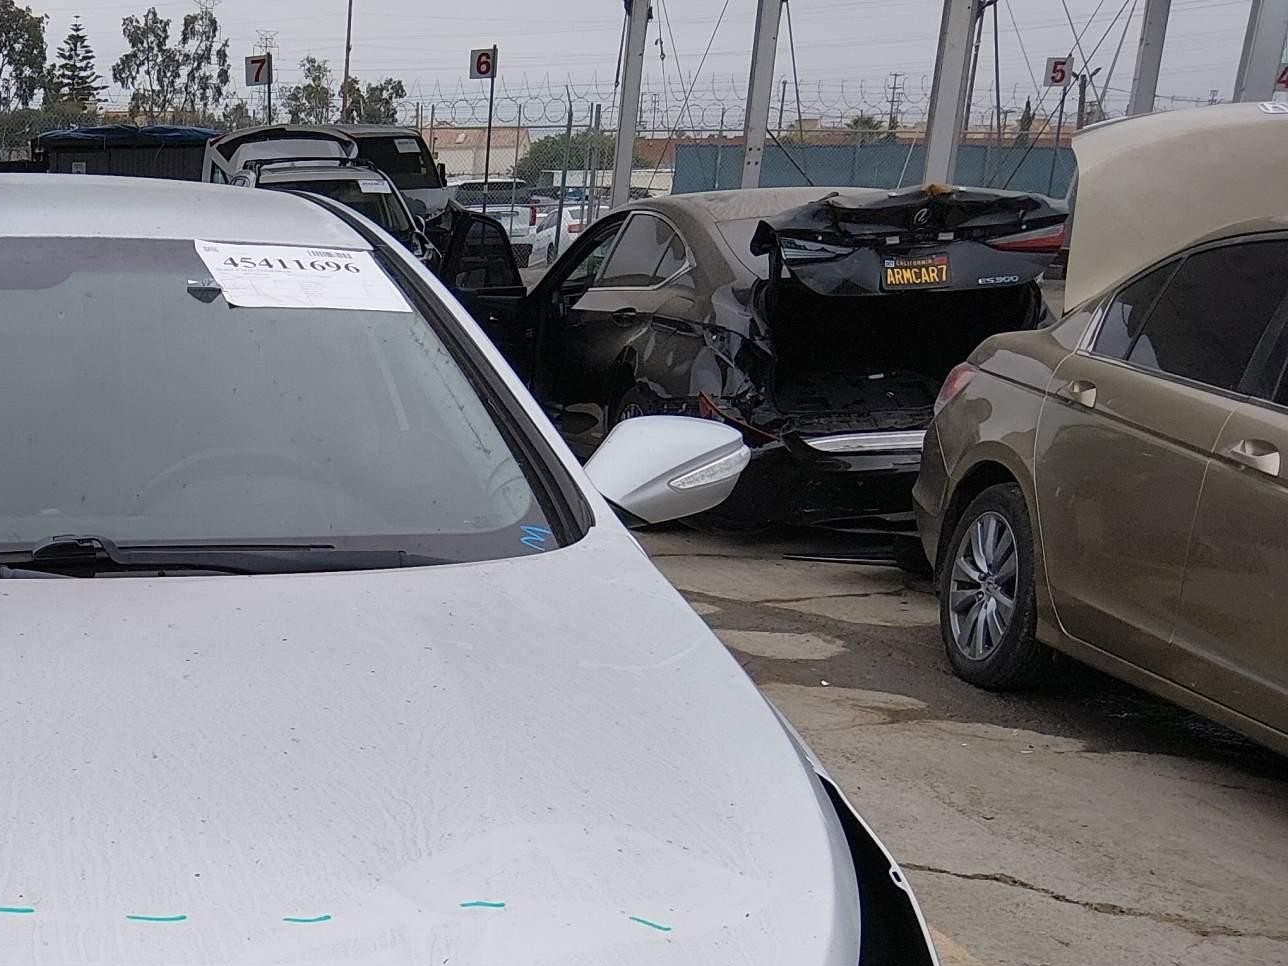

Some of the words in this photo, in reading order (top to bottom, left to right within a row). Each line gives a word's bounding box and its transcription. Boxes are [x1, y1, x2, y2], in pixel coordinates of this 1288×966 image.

[251, 58, 266, 82] 7
[476, 52, 491, 75] 6
[1051, 61, 1066, 83] 5
[223, 256, 360, 273] 45411696
[896, 258, 932, 266] CALIFORNIA
[886, 264, 947, 285] ARMCAR7
